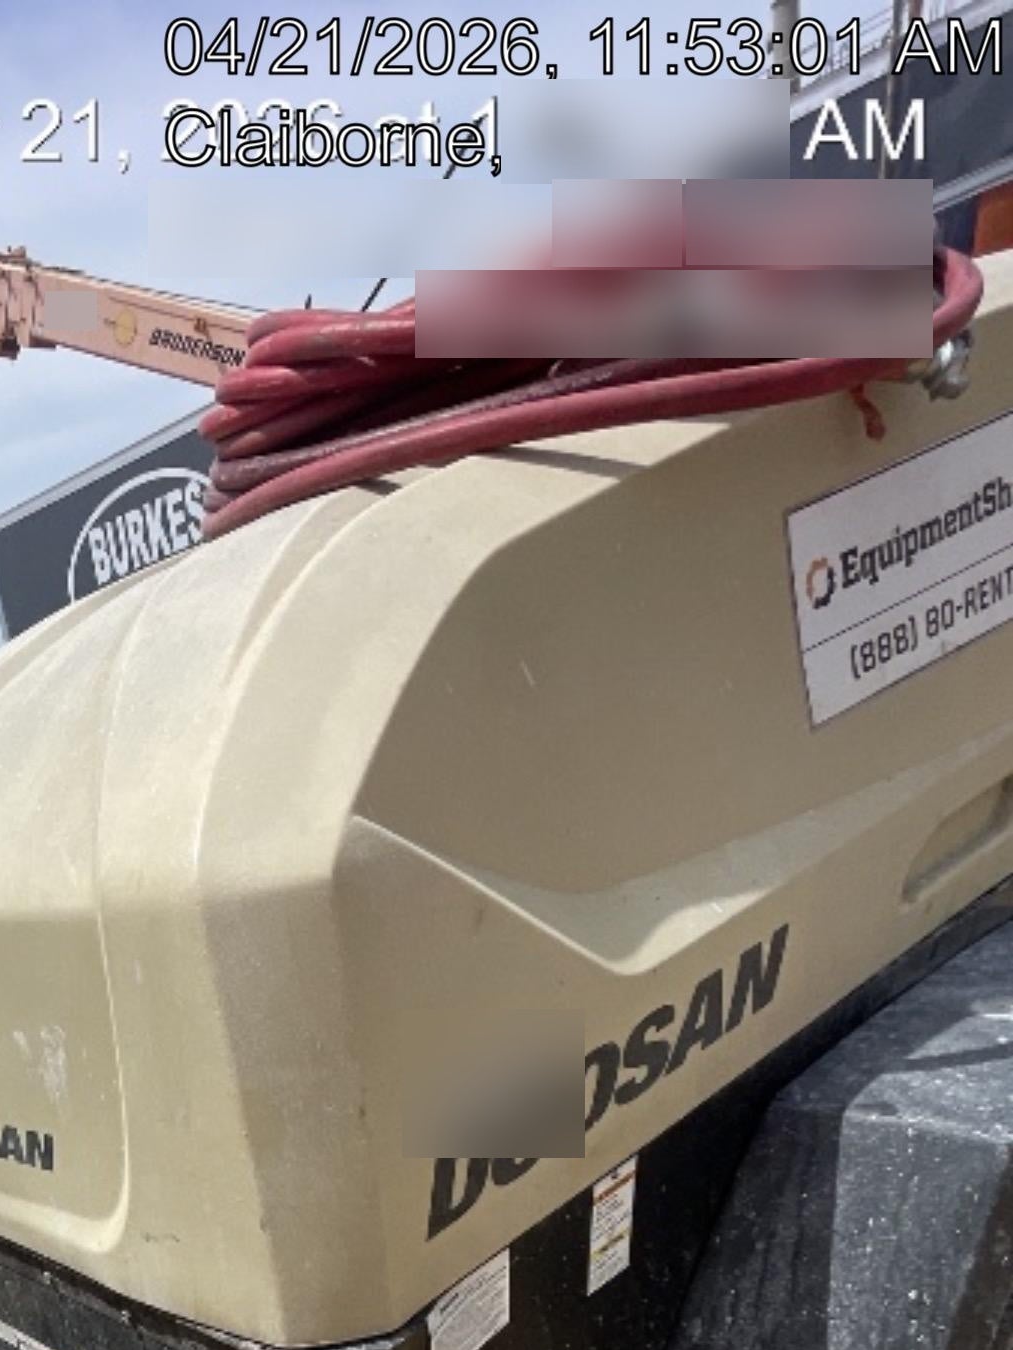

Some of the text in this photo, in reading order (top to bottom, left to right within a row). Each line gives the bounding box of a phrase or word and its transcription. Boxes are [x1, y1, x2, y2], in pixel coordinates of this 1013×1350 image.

[148, 325, 246, 367] BRODERSON
[87, 482, 207, 585] BURKES
[850, 615, 918, 680] (888)
